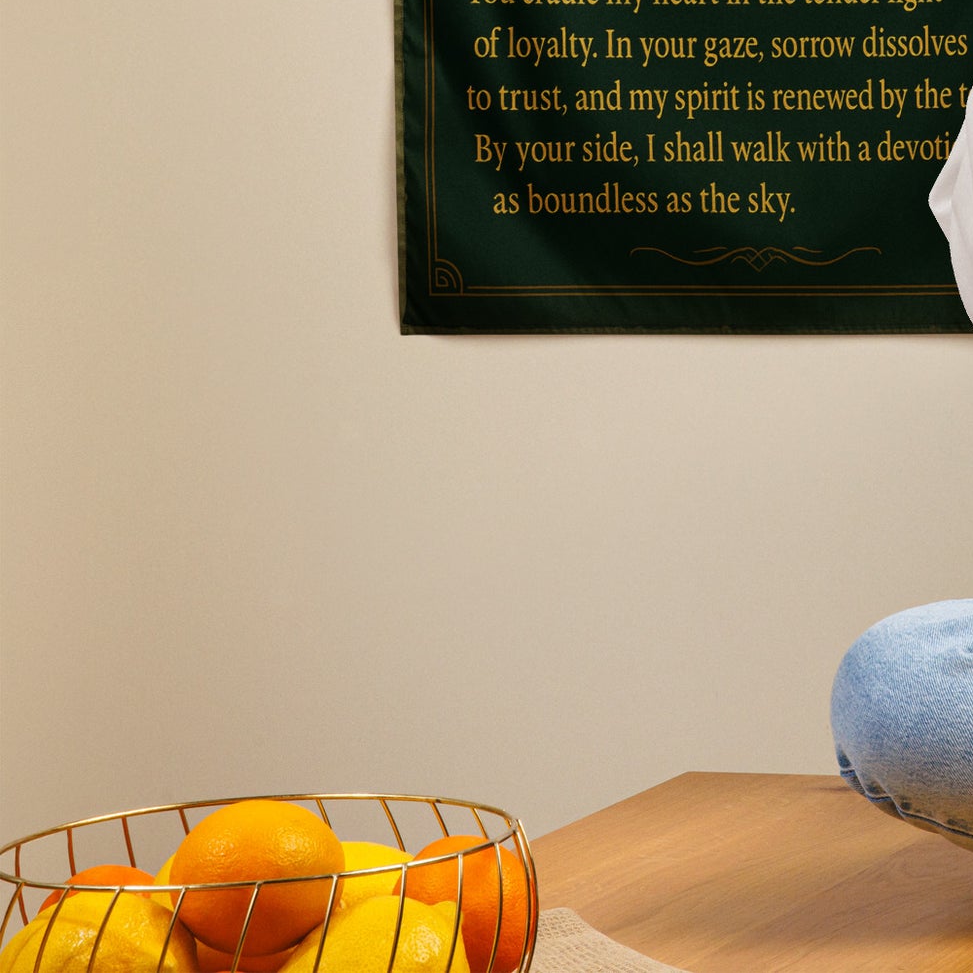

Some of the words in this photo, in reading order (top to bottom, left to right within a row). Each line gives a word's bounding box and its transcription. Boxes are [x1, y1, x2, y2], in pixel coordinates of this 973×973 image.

[474, 27, 501, 58] of
[507, 27, 598, 67] loyalty.
[605, 29, 633, 58] In
[639, 36, 697, 68] your
[704, 36, 764, 67] gaze,
[771, 35, 855, 58] sorrow
[862, 26, 968, 57] dissolves
[466, 85, 491, 111] to
[499, 84, 567, 115] trust,
[575, 81, 622, 111] and
[628, 88, 668, 119] my
[675, 82, 740, 119] spirit
[747, 82, 765, 111] is
[773, 79, 874, 111] renewed
[880, 79, 908, 118] by
[914, 78, 952, 109] the
[475, 134, 508, 171] By
[515, 140, 575, 171] your
[582, 132, 639, 166] side,
[647, 133, 657, 162] I
[664, 131, 723, 162] shall
[731, 131, 791, 162] walk
[797, 131, 851, 161] with
[857, 139, 871, 161] a
[877, 131, 954, 161] devoti
[493, 192, 519, 213] as
[527, 183, 658, 213] boundless
[666, 191, 691, 213] as
[700, 183, 740, 213] the
[748, 182, 795, 222] sky.
